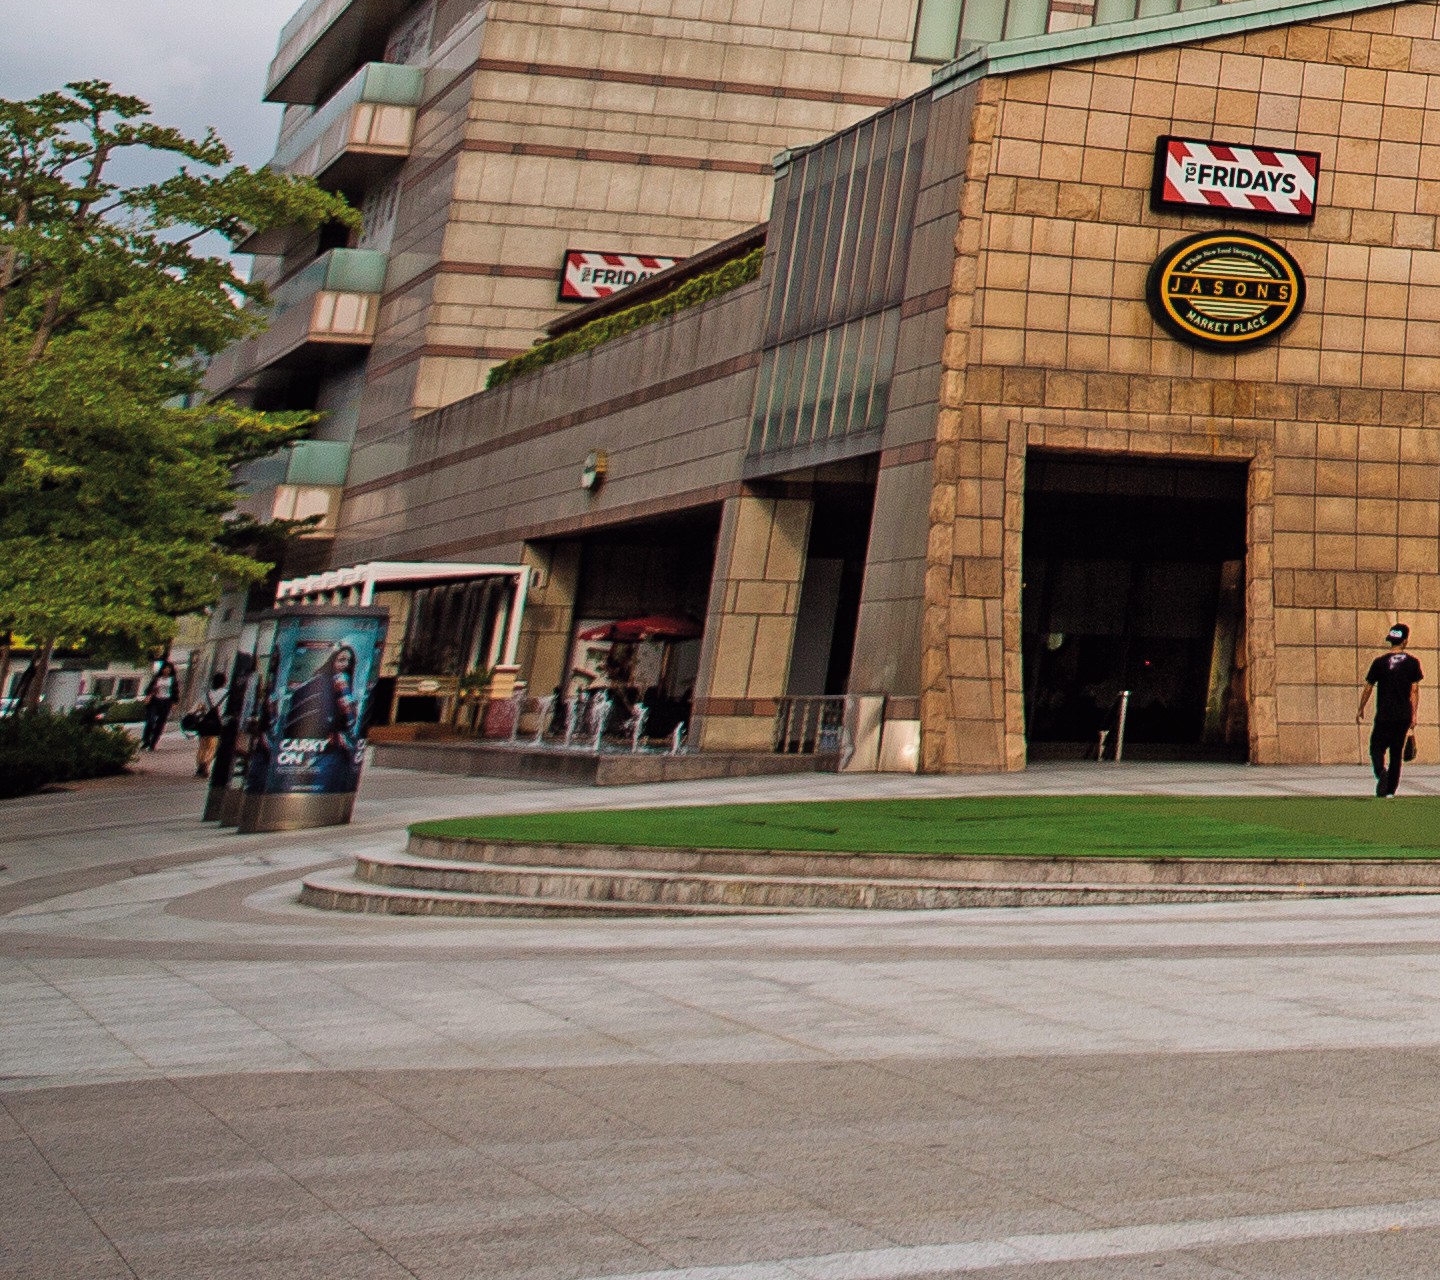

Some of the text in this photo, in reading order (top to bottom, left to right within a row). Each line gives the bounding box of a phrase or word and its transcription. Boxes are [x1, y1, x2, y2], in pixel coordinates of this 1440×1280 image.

[1184, 162, 1296, 194] TGI FRIDAYS
[1186, 310, 1268, 334] MARKET PLACE
[280, 738, 331, 752] CARRY
